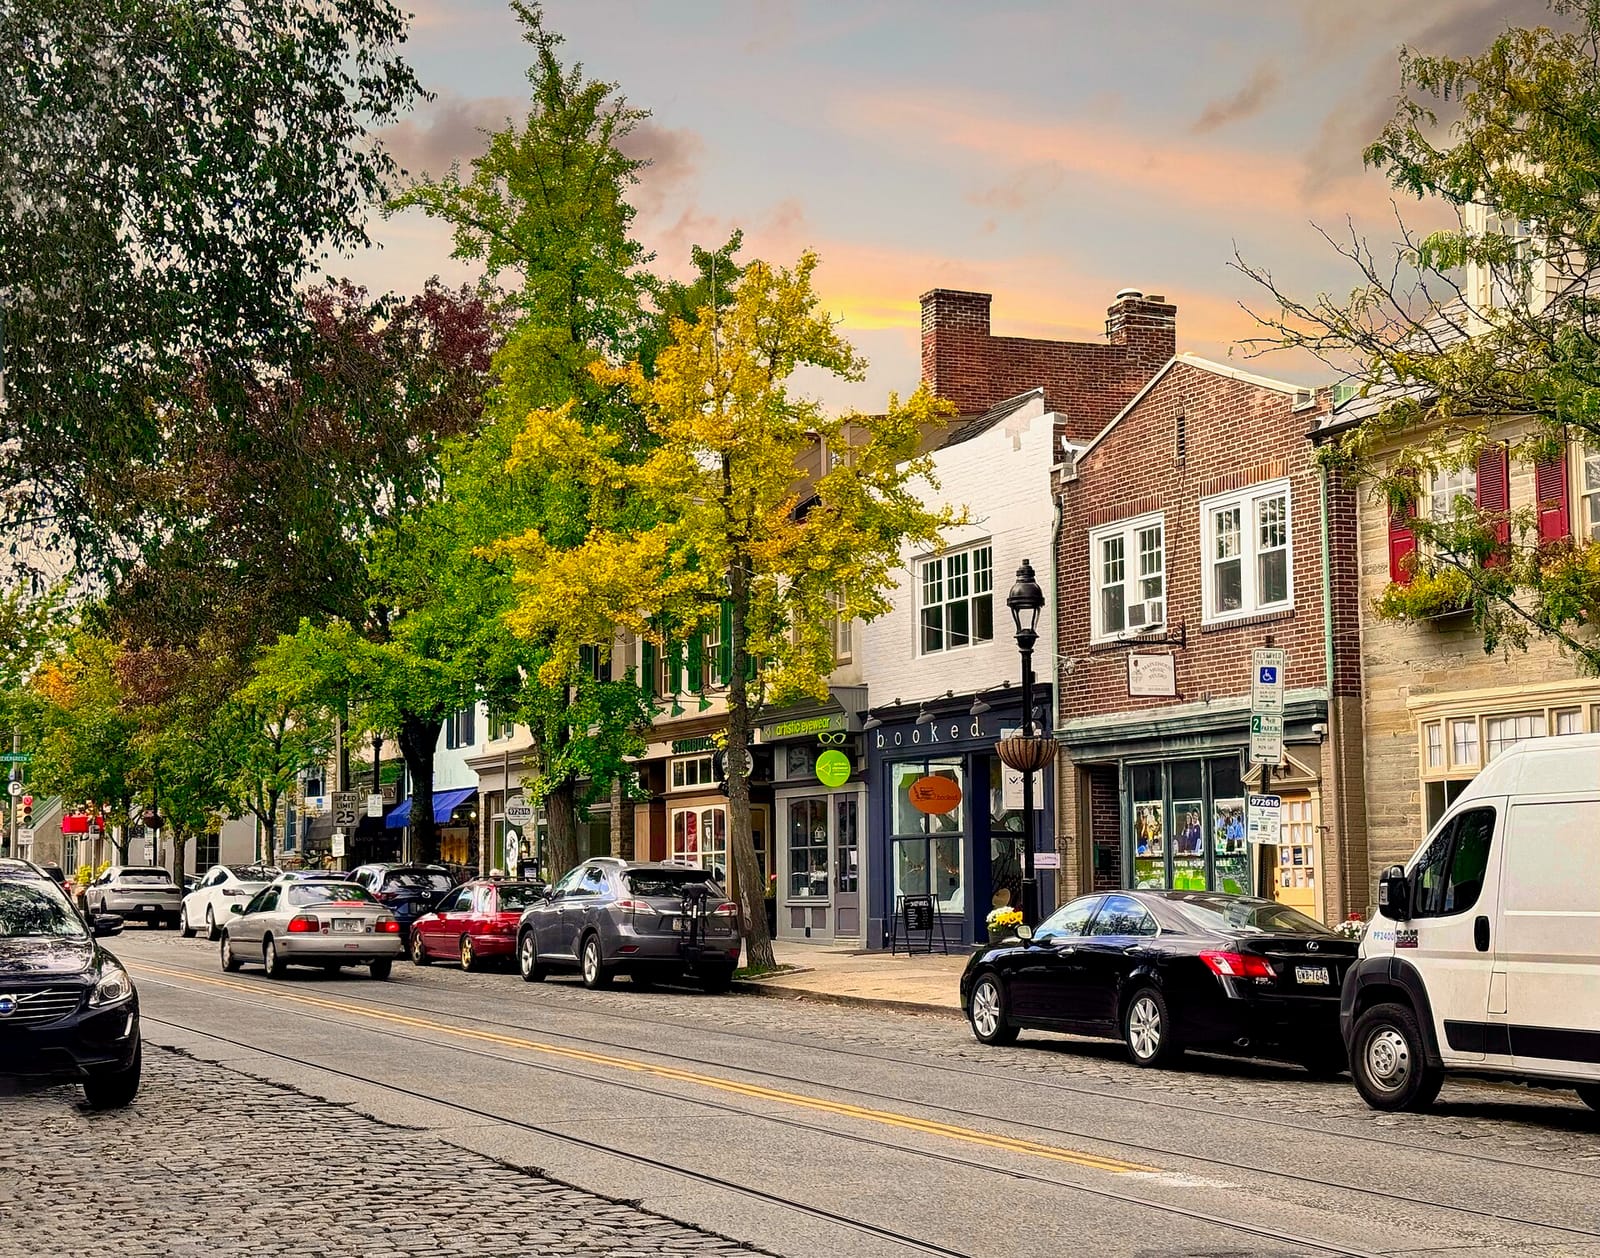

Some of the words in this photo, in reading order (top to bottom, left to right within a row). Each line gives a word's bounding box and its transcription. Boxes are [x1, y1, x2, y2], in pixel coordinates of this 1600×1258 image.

[775, 721, 800, 737] artistic
[801, 717, 831, 734] eyewear
[1252, 718, 1259, 731] 2
[876, 716, 985, 748] booked.
[12, 784, 20, 793] P
[1251, 798, 1279, 806] 972616
[336, 811, 355, 823] 25
